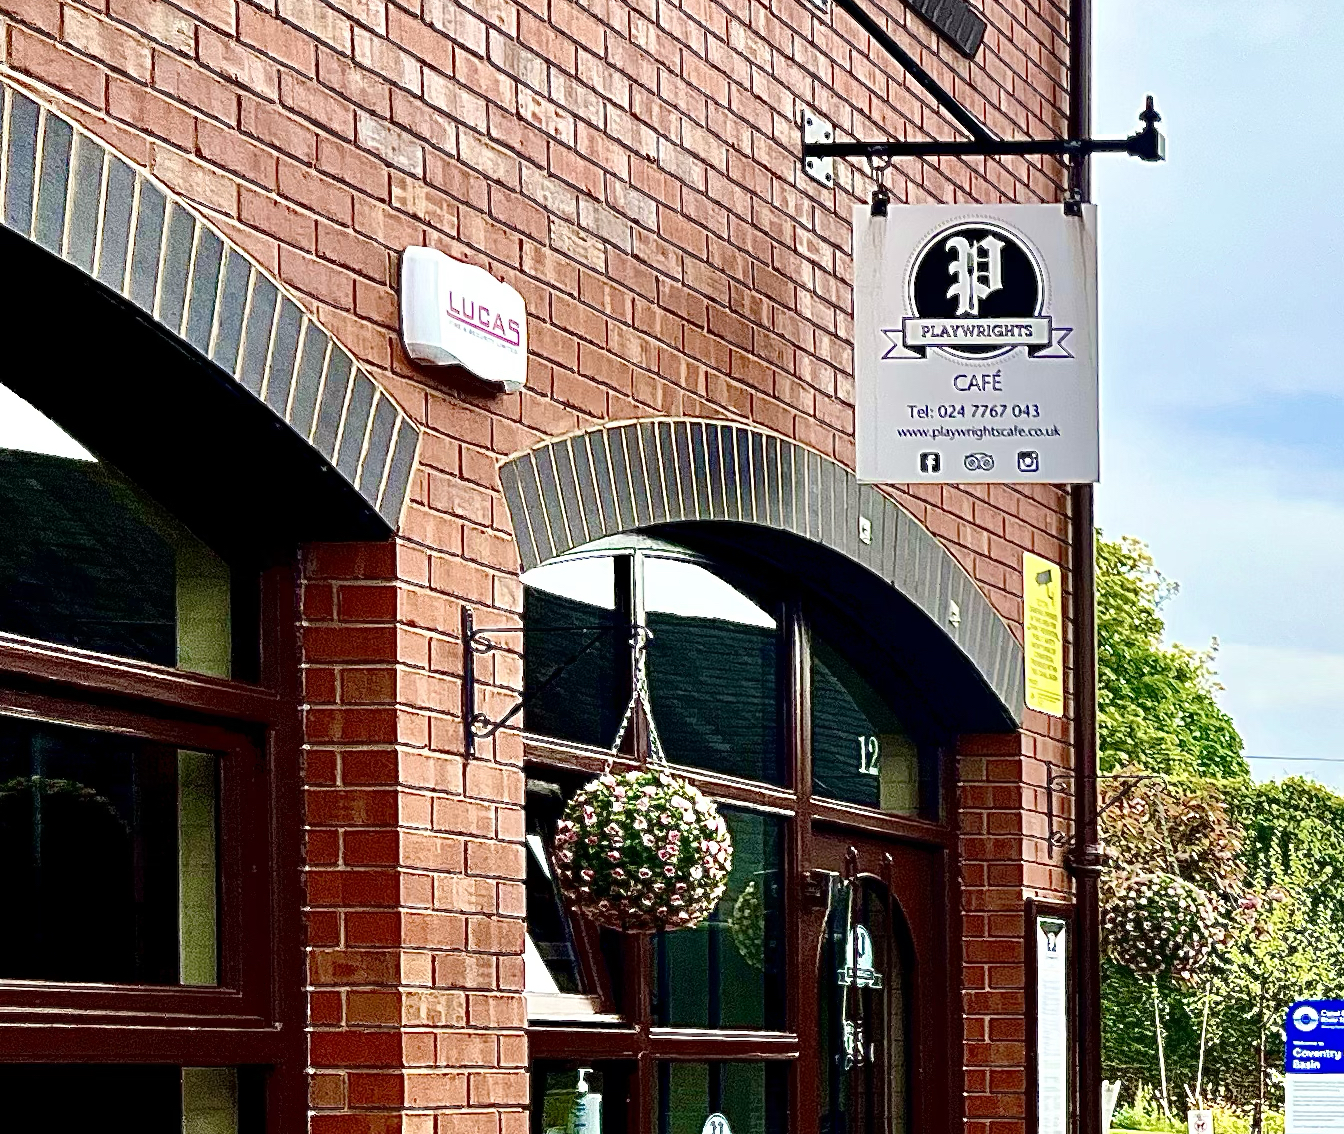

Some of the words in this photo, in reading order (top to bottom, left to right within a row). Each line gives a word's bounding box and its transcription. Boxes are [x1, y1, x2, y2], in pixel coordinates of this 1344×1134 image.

[945, 236, 1006, 316] P
[449, 291, 520, 342] LUCAS
[921, 324, 1033, 338] PLAYWRIGHTS
[953, 369, 1003, 392] CAFÉ
[907, 405, 934, 419] Tel:
[938, 405, 966, 419] 024
[971, 405, 1007, 419] 7767
[1012, 404, 1040, 418] 043
[897, 424, 1061, 441] www.playwrightscafe.co.uk
[858, 735, 879, 776] 12
[1292, 1047, 1342, 1060] Coventry
[1292, 1059, 1321, 1070] Basin
